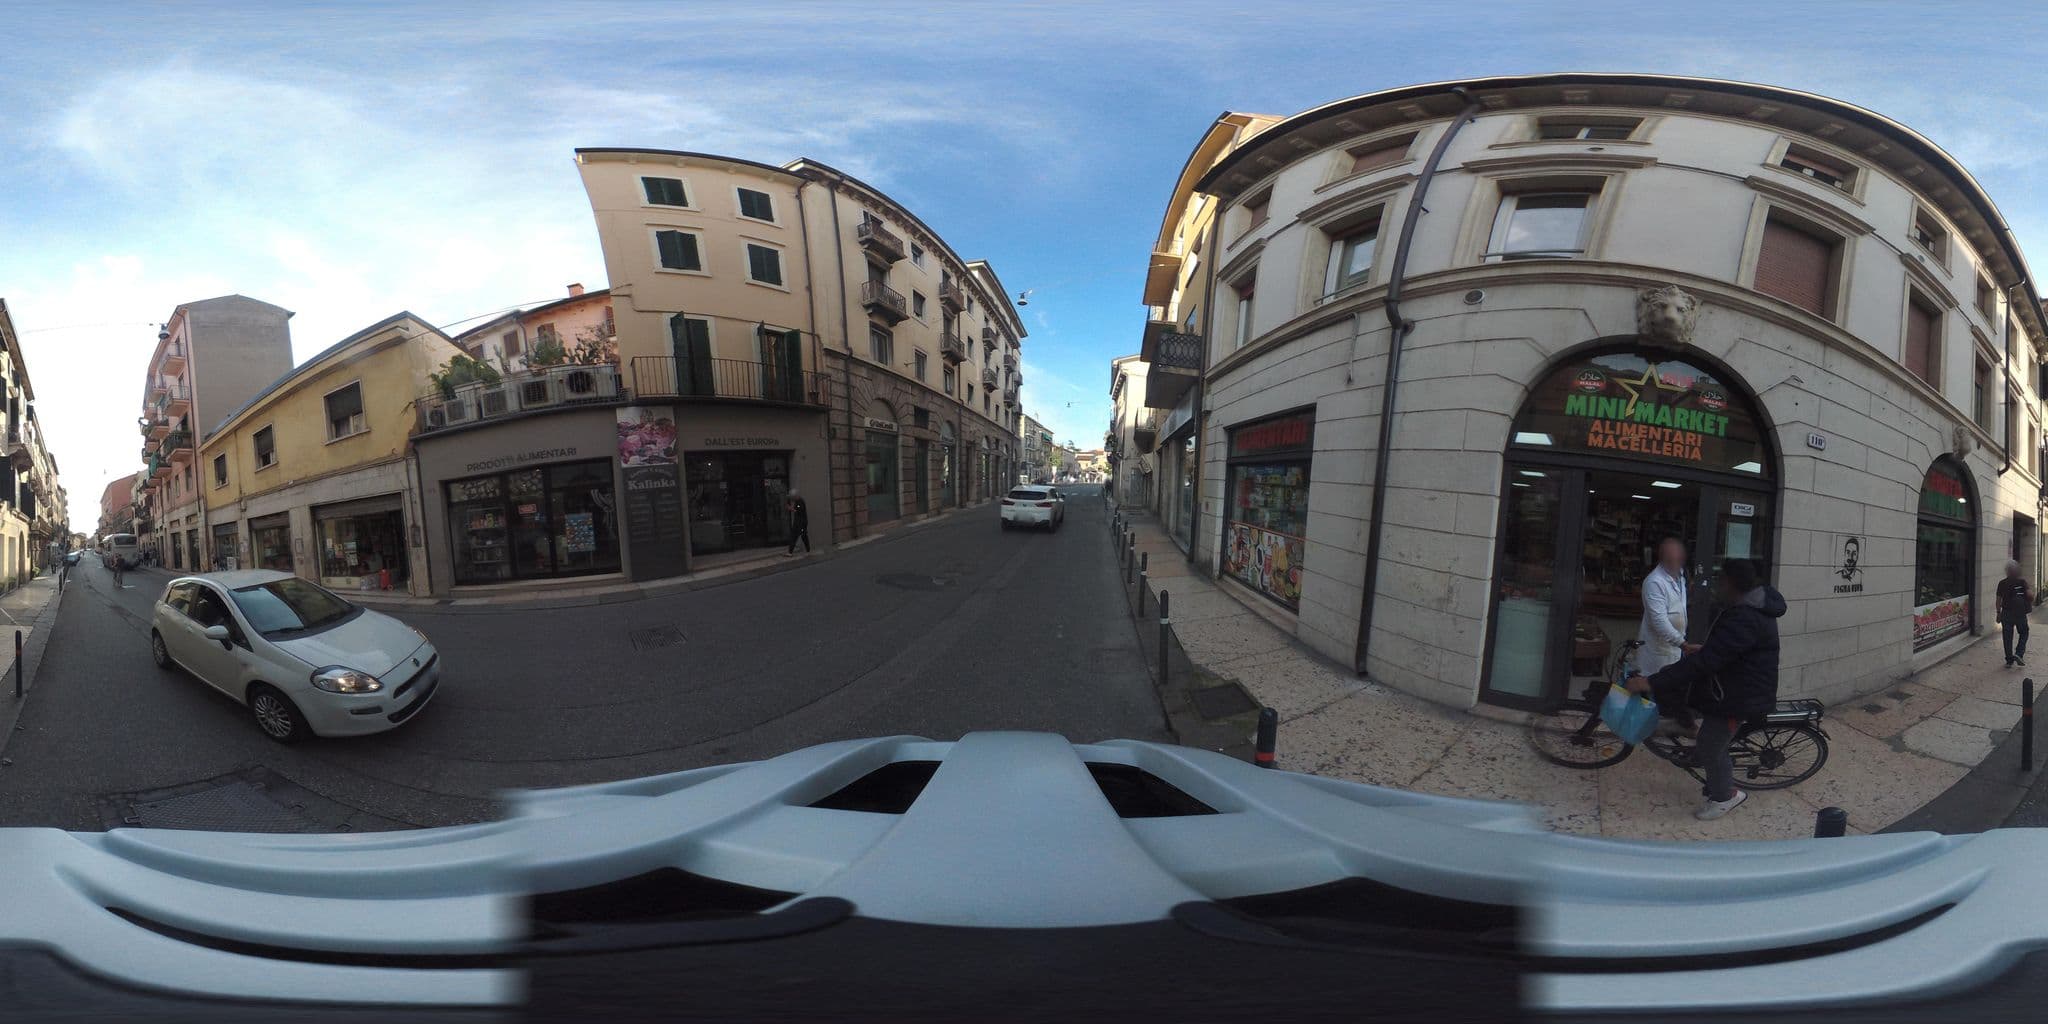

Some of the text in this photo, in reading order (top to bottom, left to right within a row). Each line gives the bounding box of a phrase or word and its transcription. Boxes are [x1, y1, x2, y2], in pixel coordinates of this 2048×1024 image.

[1565, 394, 1728, 437] MINI MARKET
[704, 438, 780, 446] DALL'EST EUROPA
[1590, 419, 1703, 446] ALIMENTARI
[1587, 432, 1703, 461] MACELLERIA
[467, 448, 577, 472] PRODOTTI ALIMENTARI
[627, 478, 676, 490] Kalinka
